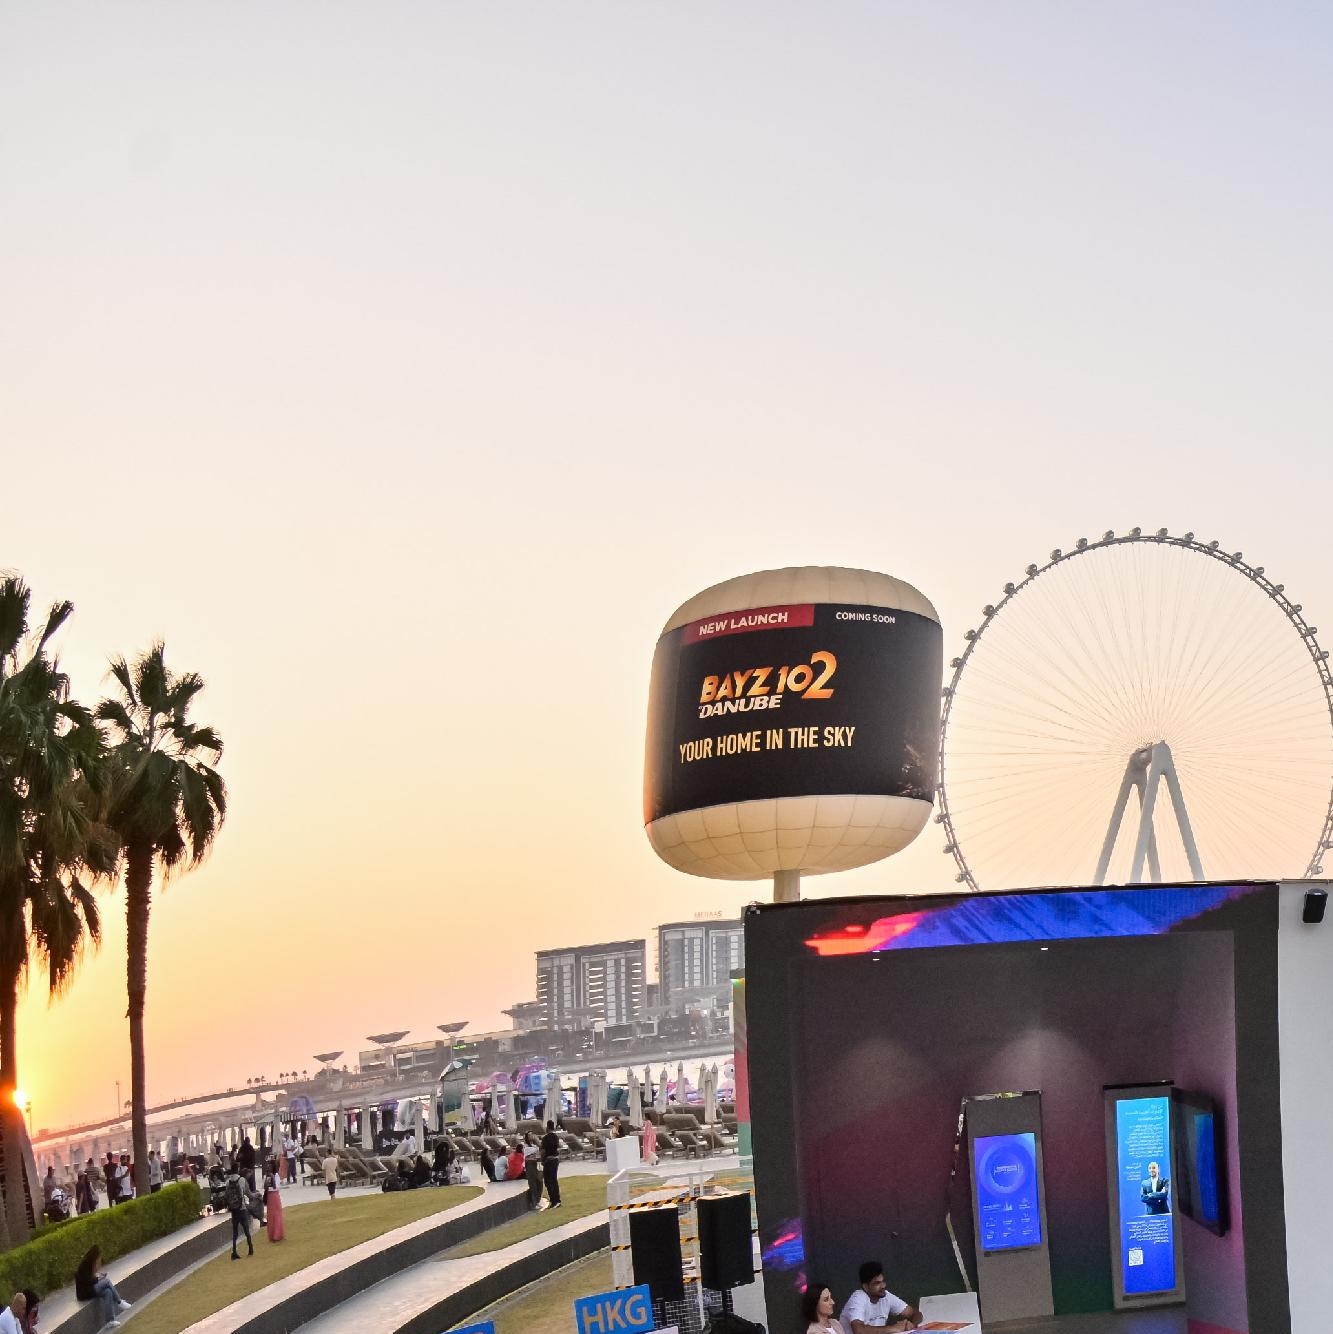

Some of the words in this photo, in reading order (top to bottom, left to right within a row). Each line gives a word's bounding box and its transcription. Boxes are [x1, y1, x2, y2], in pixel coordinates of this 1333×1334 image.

[699, 619, 727, 636] NEW
[730, 612, 789, 629] LAUNCH
[835, 612, 870, 623] COMING
[872, 613, 896, 624] SOON
[699, 667, 772, 703] BAYZ
[777, 650, 838, 700] 102
[699, 694, 783, 719] DANUBE
[680, 738, 712, 764] YOUR
[716, 730, 761, 756] HOME
[766, 729, 783, 750] IN
[789, 727, 818, 748] THE
[824, 726, 856, 747] SKY
